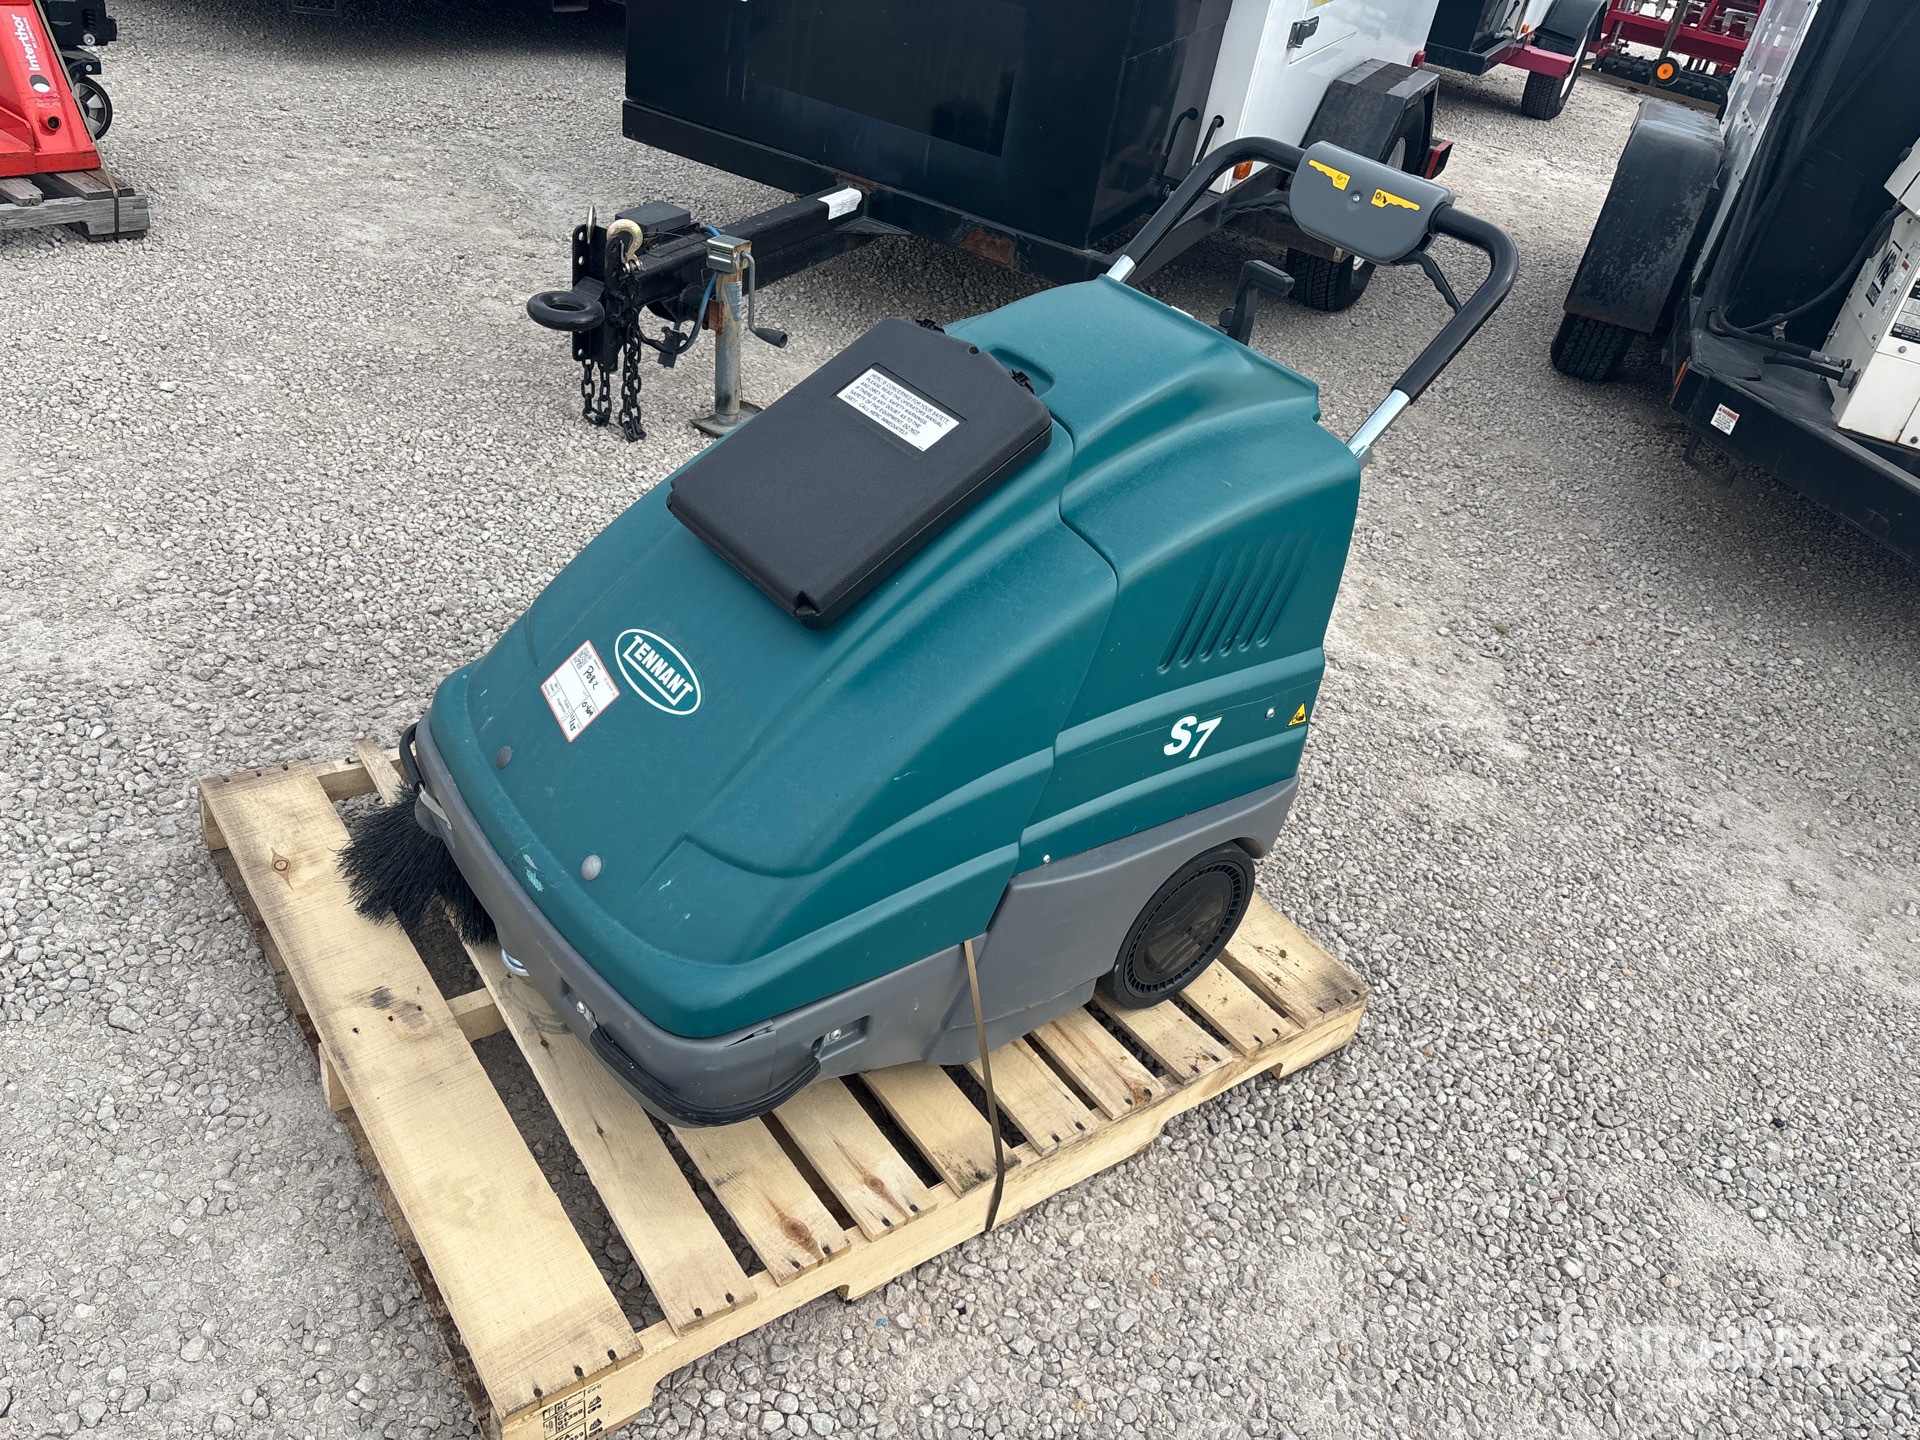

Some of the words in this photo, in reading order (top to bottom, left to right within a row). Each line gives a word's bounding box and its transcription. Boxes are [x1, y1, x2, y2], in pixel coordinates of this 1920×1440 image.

[12, 14, 41, 71] Interthor
[849, 389, 866, 400] SAFETY
[908, 427, 920, 435] NOT
[857, 402, 871, 411] CALL
[858, 387, 873, 397] THERE
[876, 398, 886, 406] ANY
[884, 404, 901, 415] DOUBT
[910, 420, 921, 428] THE
[865, 377, 882, 388] PLEASE
[880, 386, 893, 395] READ
[924, 414, 944, 427] MANUAL
[868, 386, 881, 395] OBEY
[887, 398, 905, 410] SAFETY
[885, 382, 912, 400] CONCERNED
[919, 403, 933, 413] YOUR
[622, 634, 694, 706] TENNANT
[1163, 715, 1222, 759] S7
